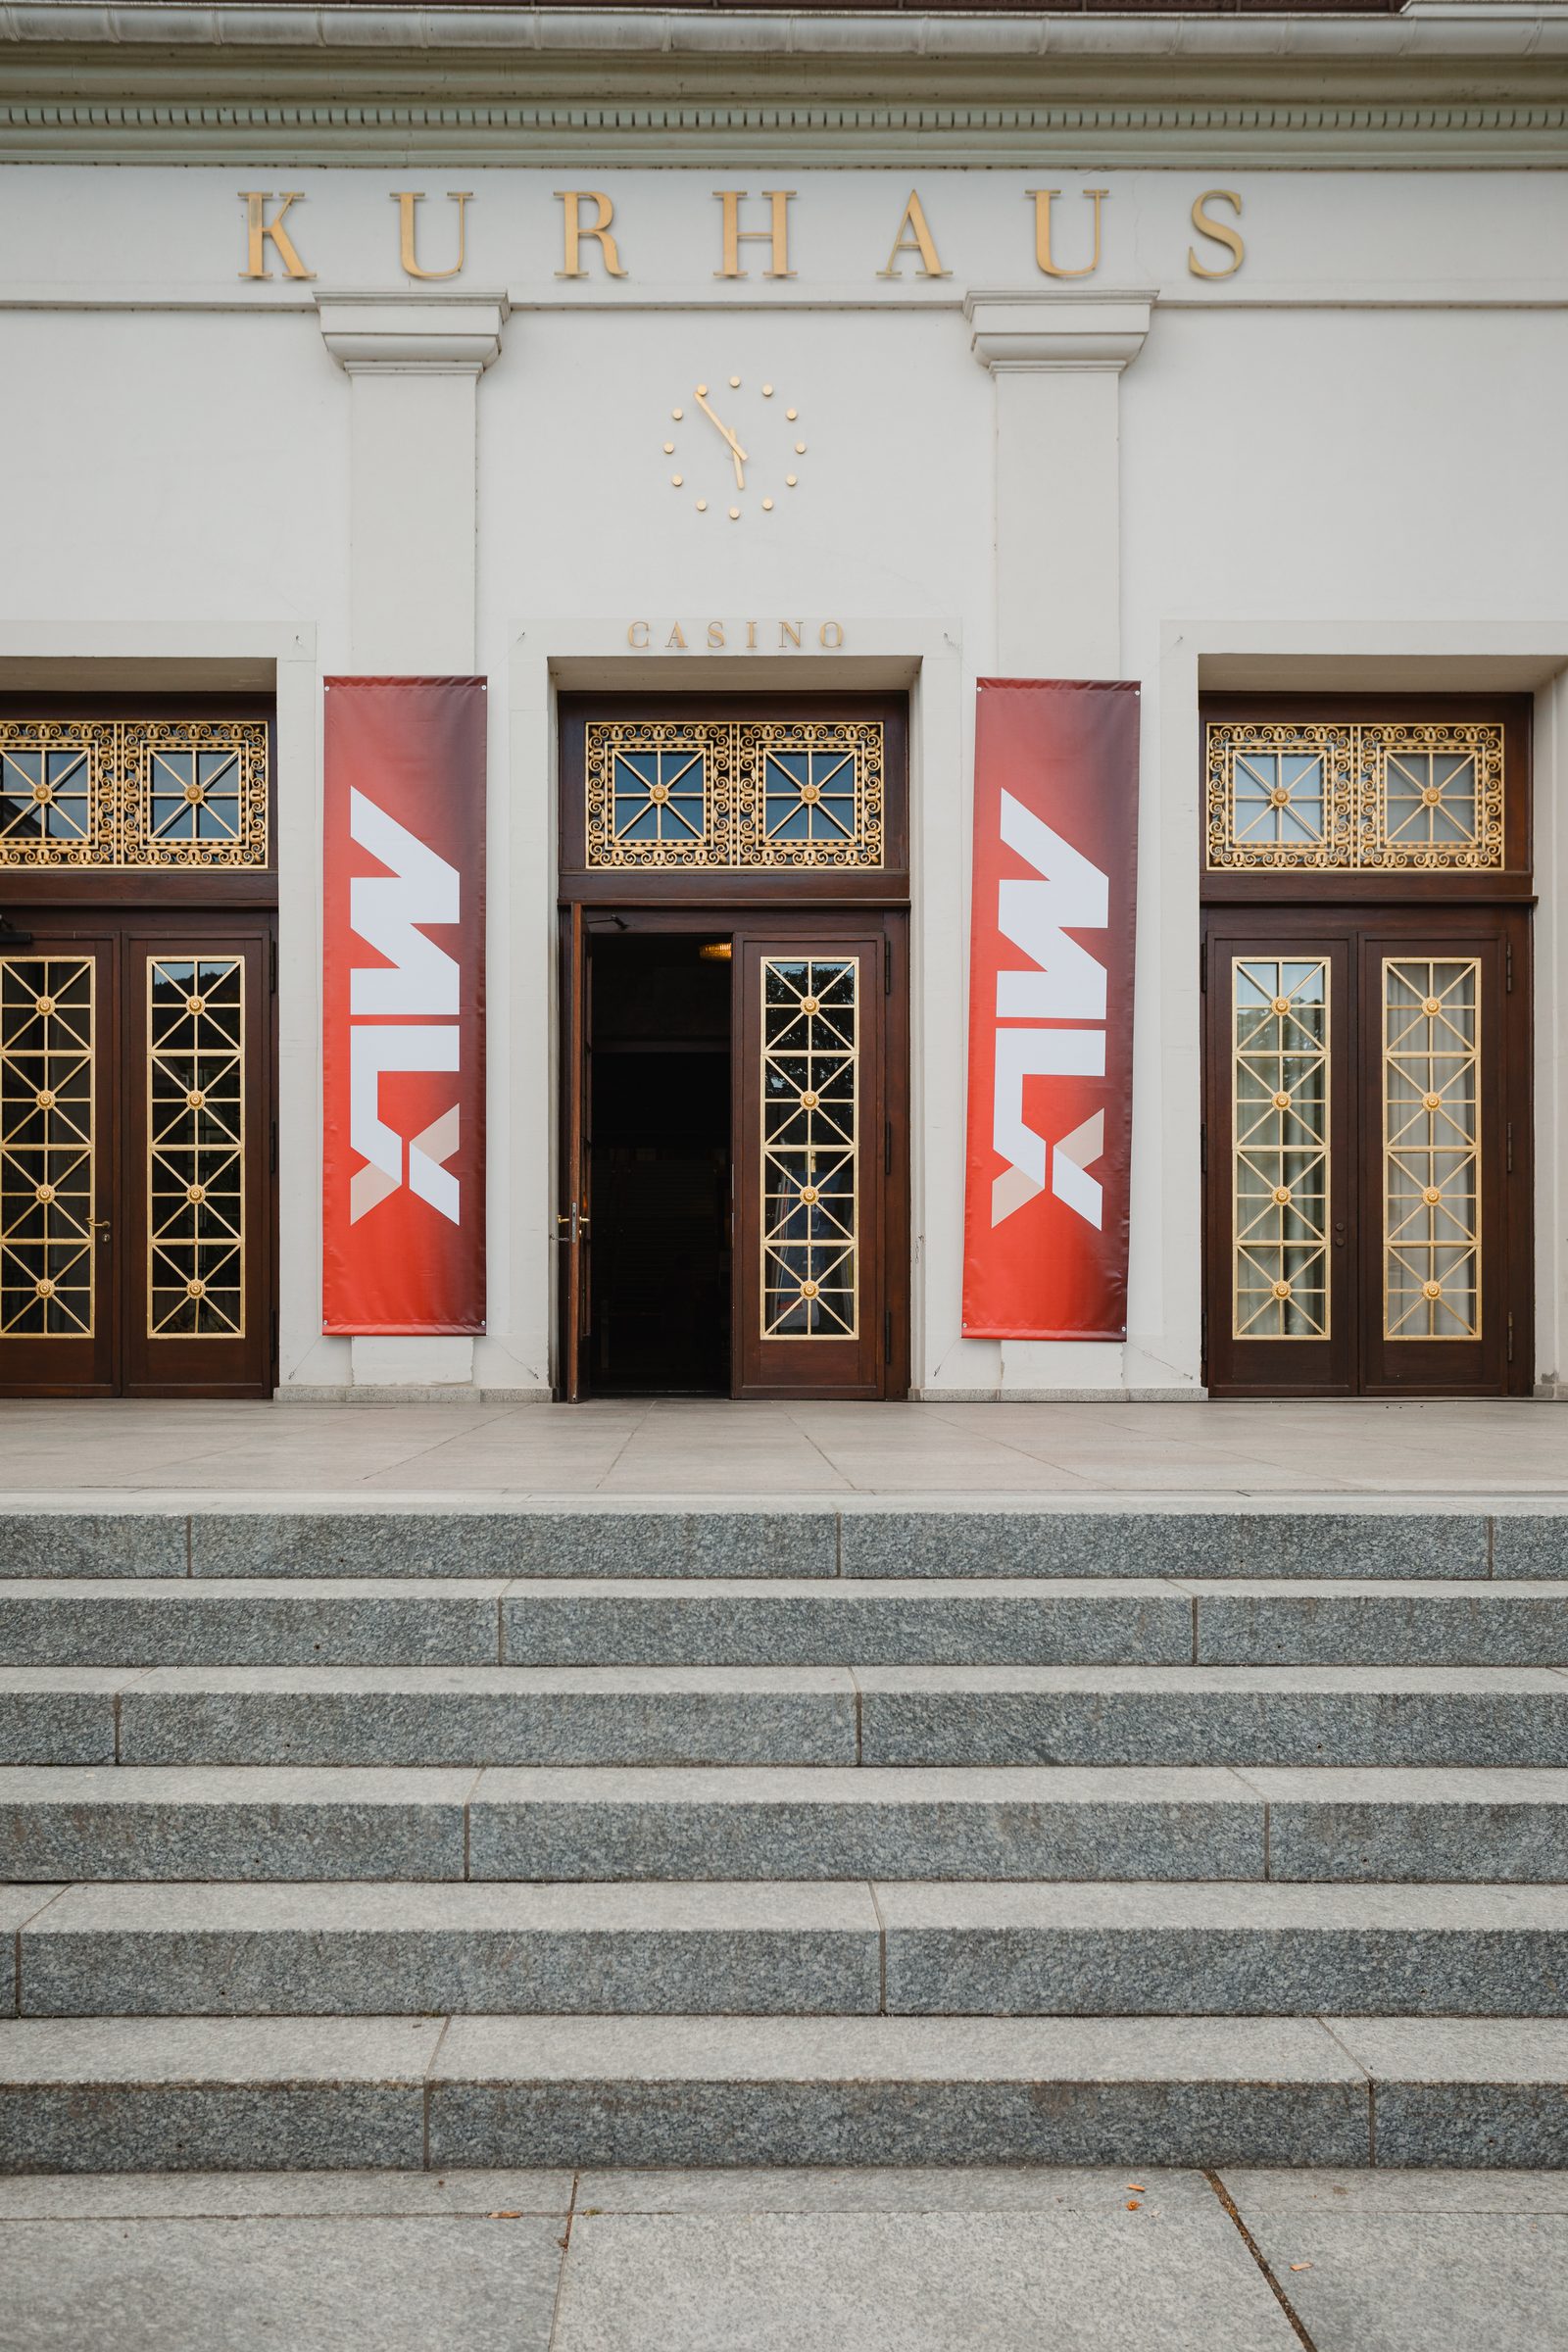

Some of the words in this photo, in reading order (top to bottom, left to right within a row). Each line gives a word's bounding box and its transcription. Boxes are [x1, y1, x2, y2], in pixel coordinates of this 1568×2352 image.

[239, 188, 1246, 280] KURHAUS
[627, 620, 844, 649] CASINO
[350, 785, 460, 1226] MLX
[992, 787, 1109, 1231] MLX
